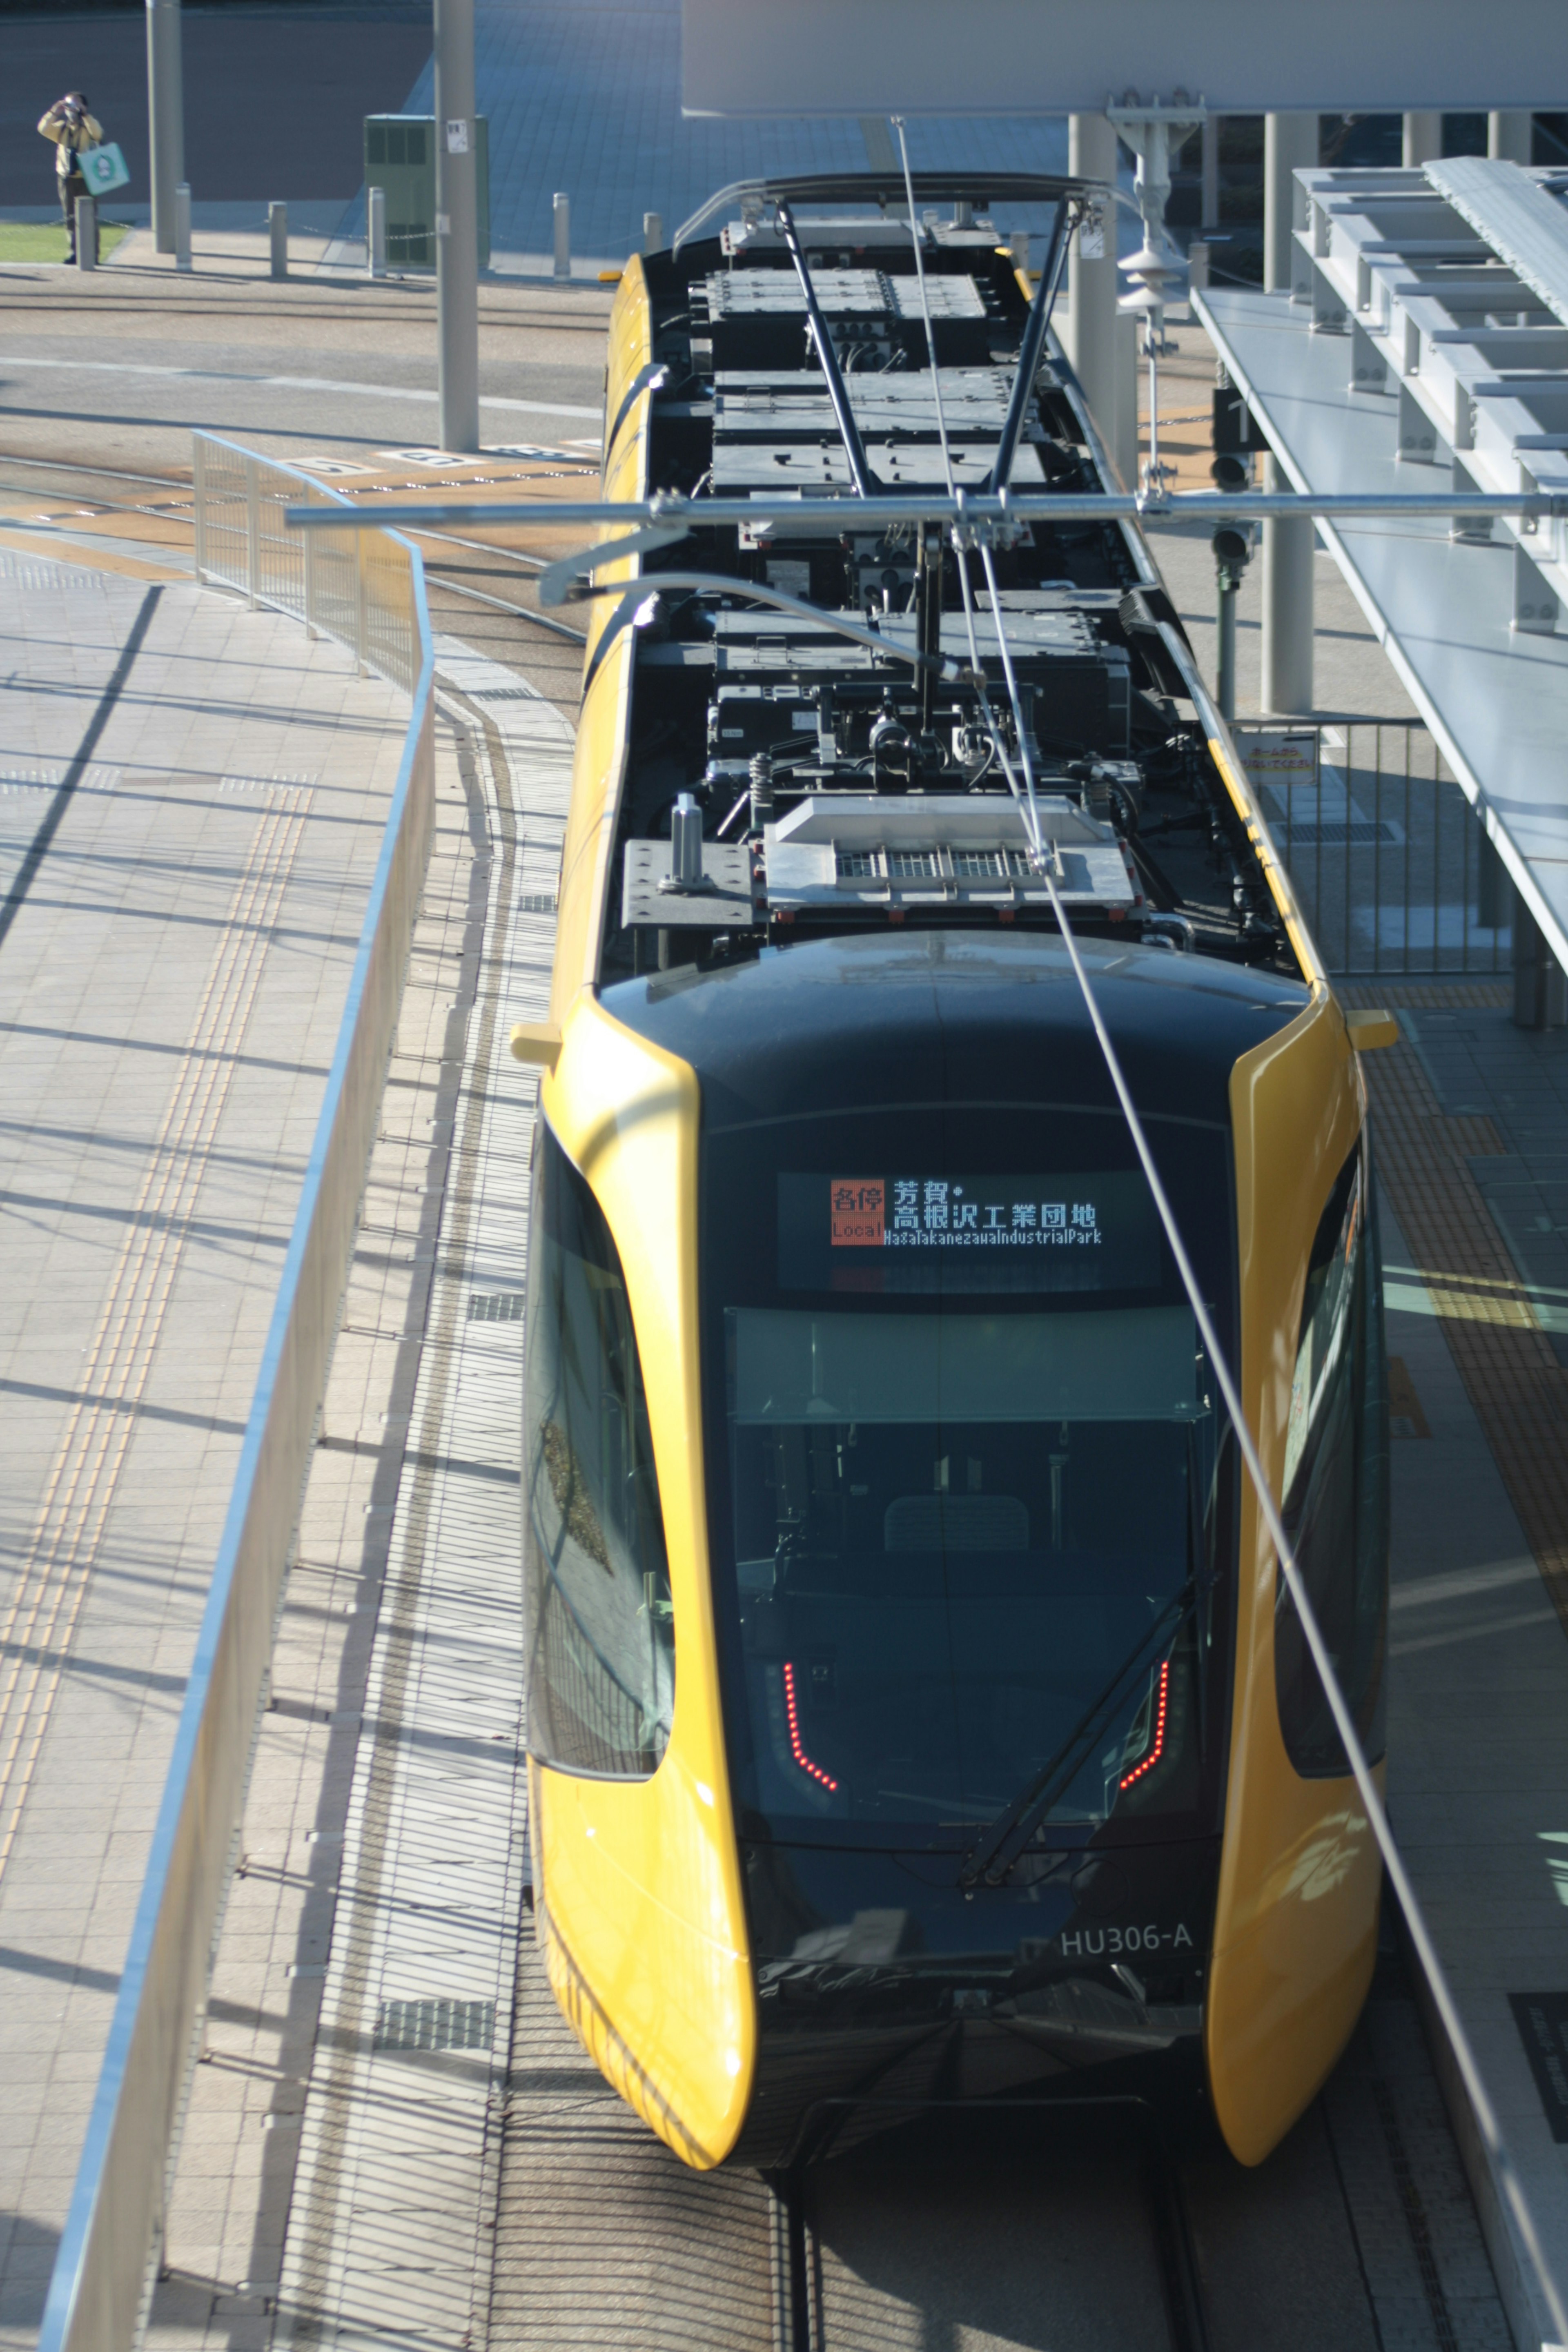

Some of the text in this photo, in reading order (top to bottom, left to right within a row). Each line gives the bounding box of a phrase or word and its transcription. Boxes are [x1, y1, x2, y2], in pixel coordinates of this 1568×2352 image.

[1251, 747, 1298, 756] ホームから
[833, 1187, 882, 1211] 各停
[894, 1204, 1096, 1228] 高根沢工業団地
[833, 1220, 882, 1238] Local
[1061, 1923, 1193, 1956] HU306-A
